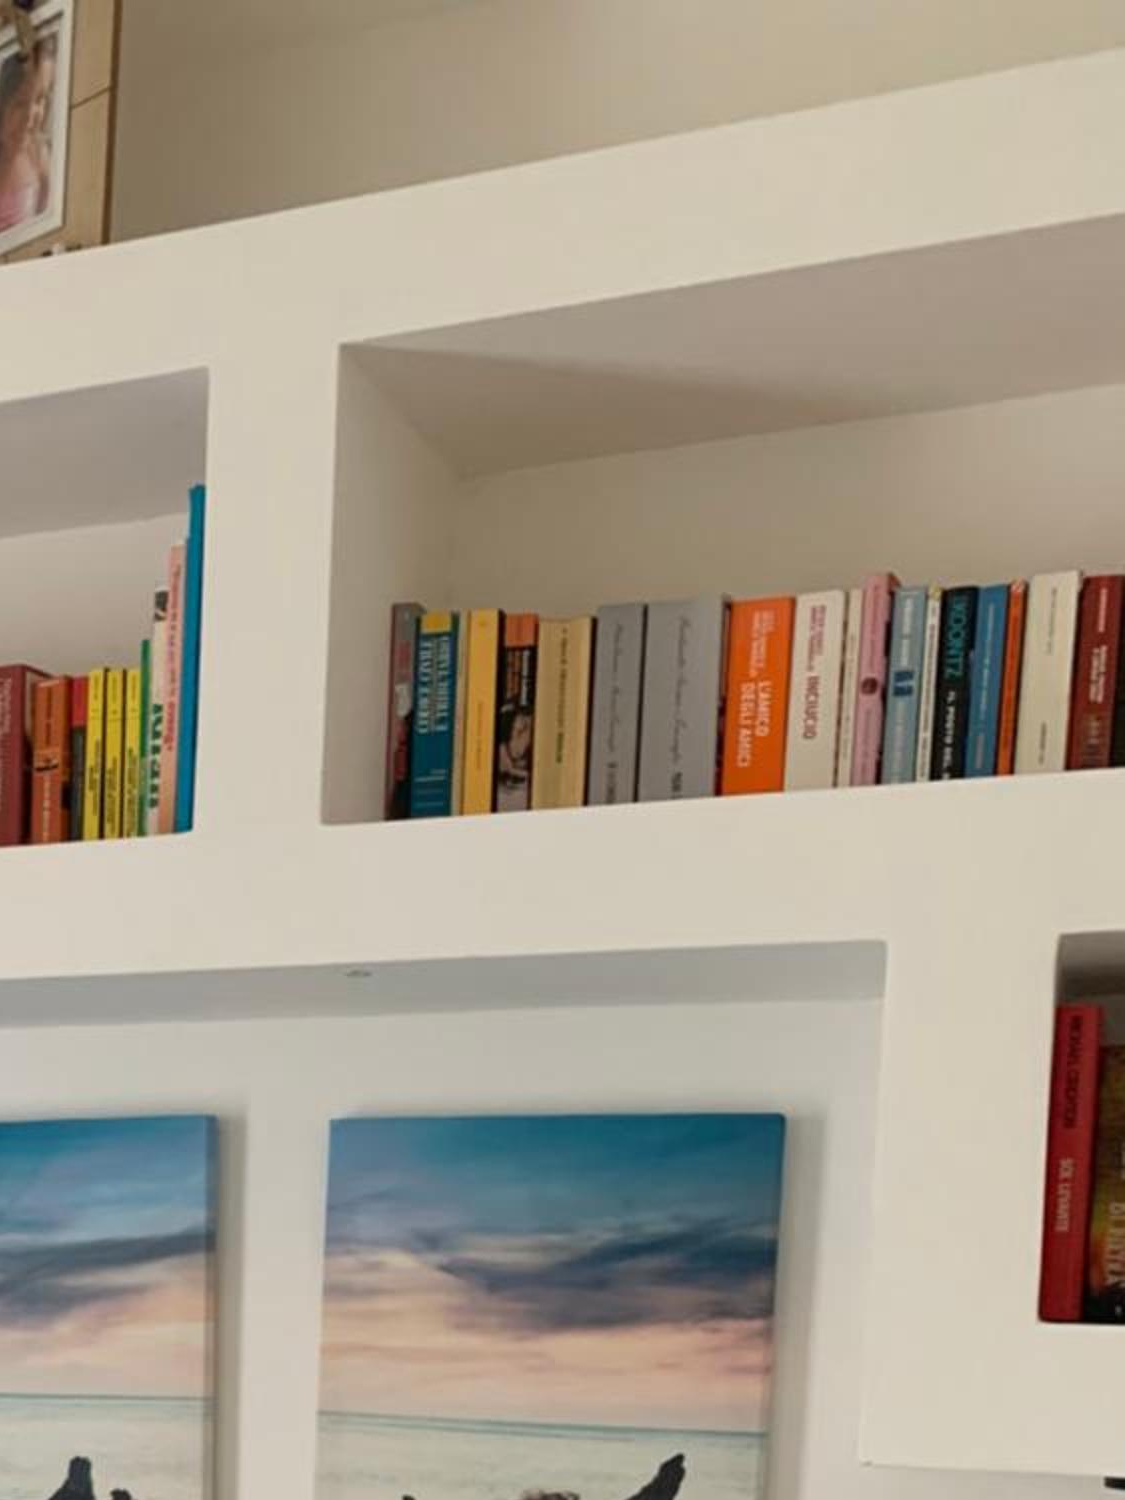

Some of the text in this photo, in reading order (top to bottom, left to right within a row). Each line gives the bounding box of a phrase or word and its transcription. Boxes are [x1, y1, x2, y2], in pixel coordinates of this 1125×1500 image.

[944, 602, 967, 680] KOONTZ
[736, 682, 755, 768] DEGLI AMICI
[756, 679, 773, 736] L'AMICO
[803, 675, 820, 740] INCIUCIO
